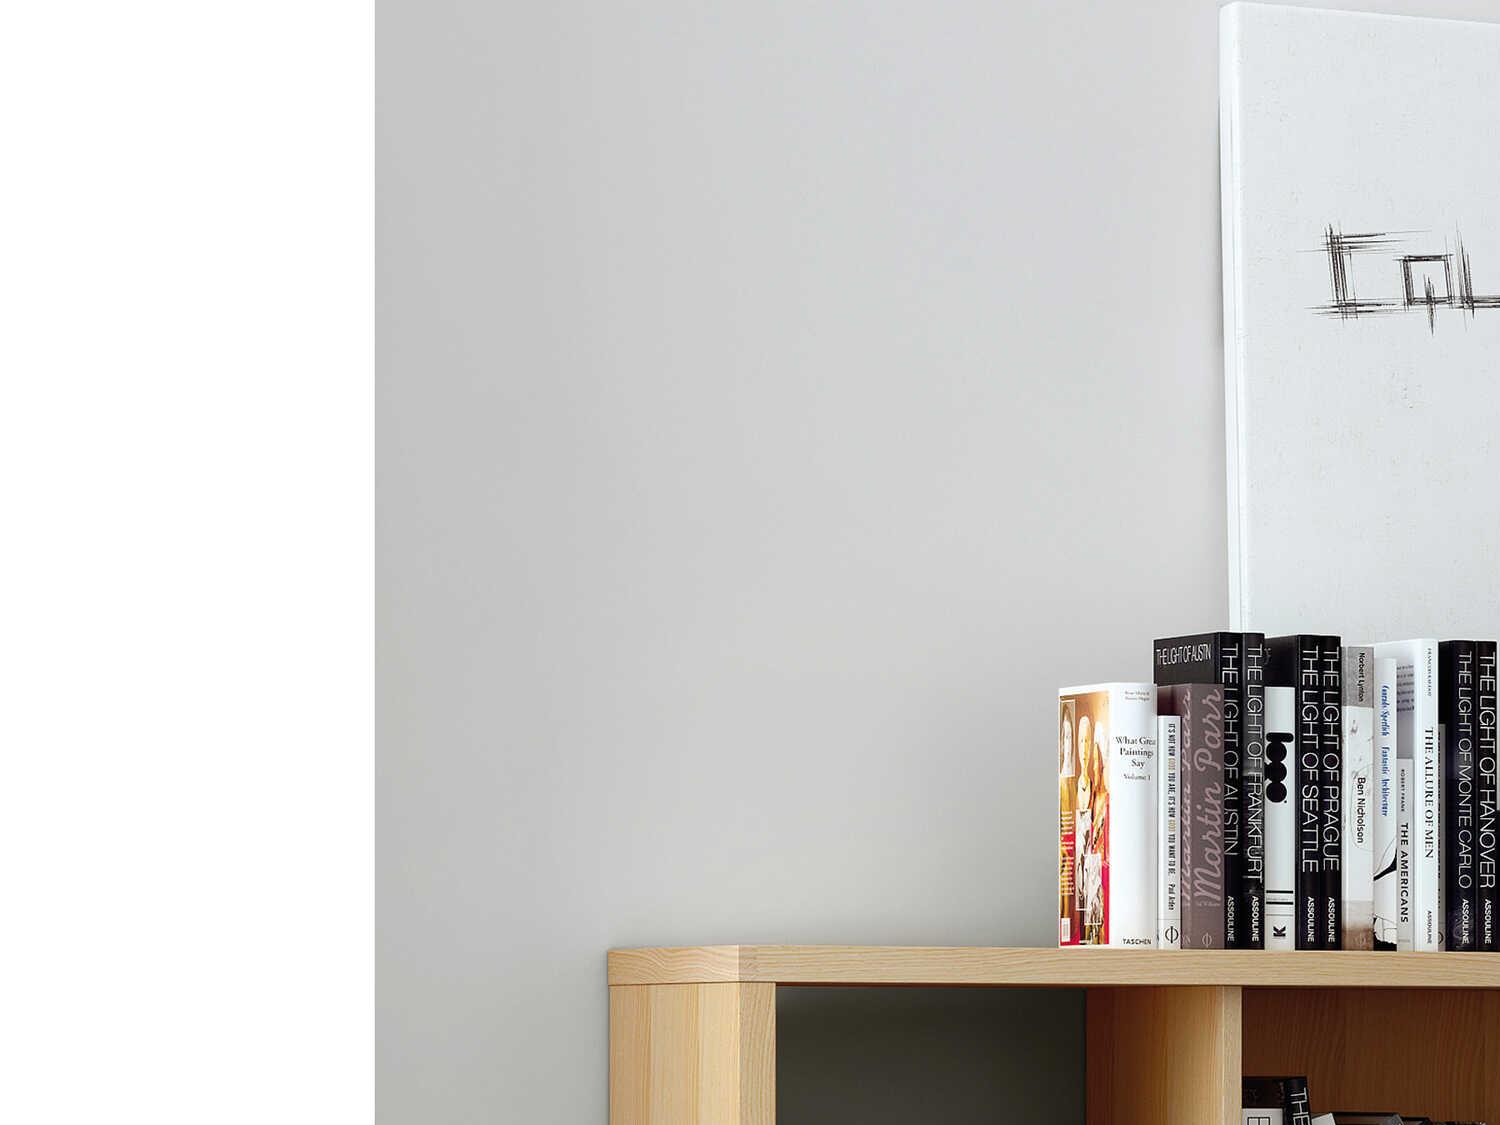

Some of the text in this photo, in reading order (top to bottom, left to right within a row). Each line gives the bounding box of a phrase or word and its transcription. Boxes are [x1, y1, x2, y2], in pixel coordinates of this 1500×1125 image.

[1222, 643, 1238, 684] THE
[1222, 688, 1238, 747] LIGHT
[1222, 750, 1238, 779] OF
[1247, 644, 1262, 883] THE LIGHT OF FRANKFURT
[1302, 645, 1319, 873] THE LIGHT OF SEATTLE
[1323, 646, 1340, 871] THE LIGHT OF PRAGUE
[1356, 777, 1366, 844] Ben Nicholson
[1458, 651, 1472, 889] THE LIGHT OF MONTE CARLO
[1480, 652, 1496, 889] THE LIGHT OF HANOVER
[1193, 782, 1221, 901] Martin
[1400, 823, 1409, 845] THE
[1400, 851, 1409, 923] AMERICANS
